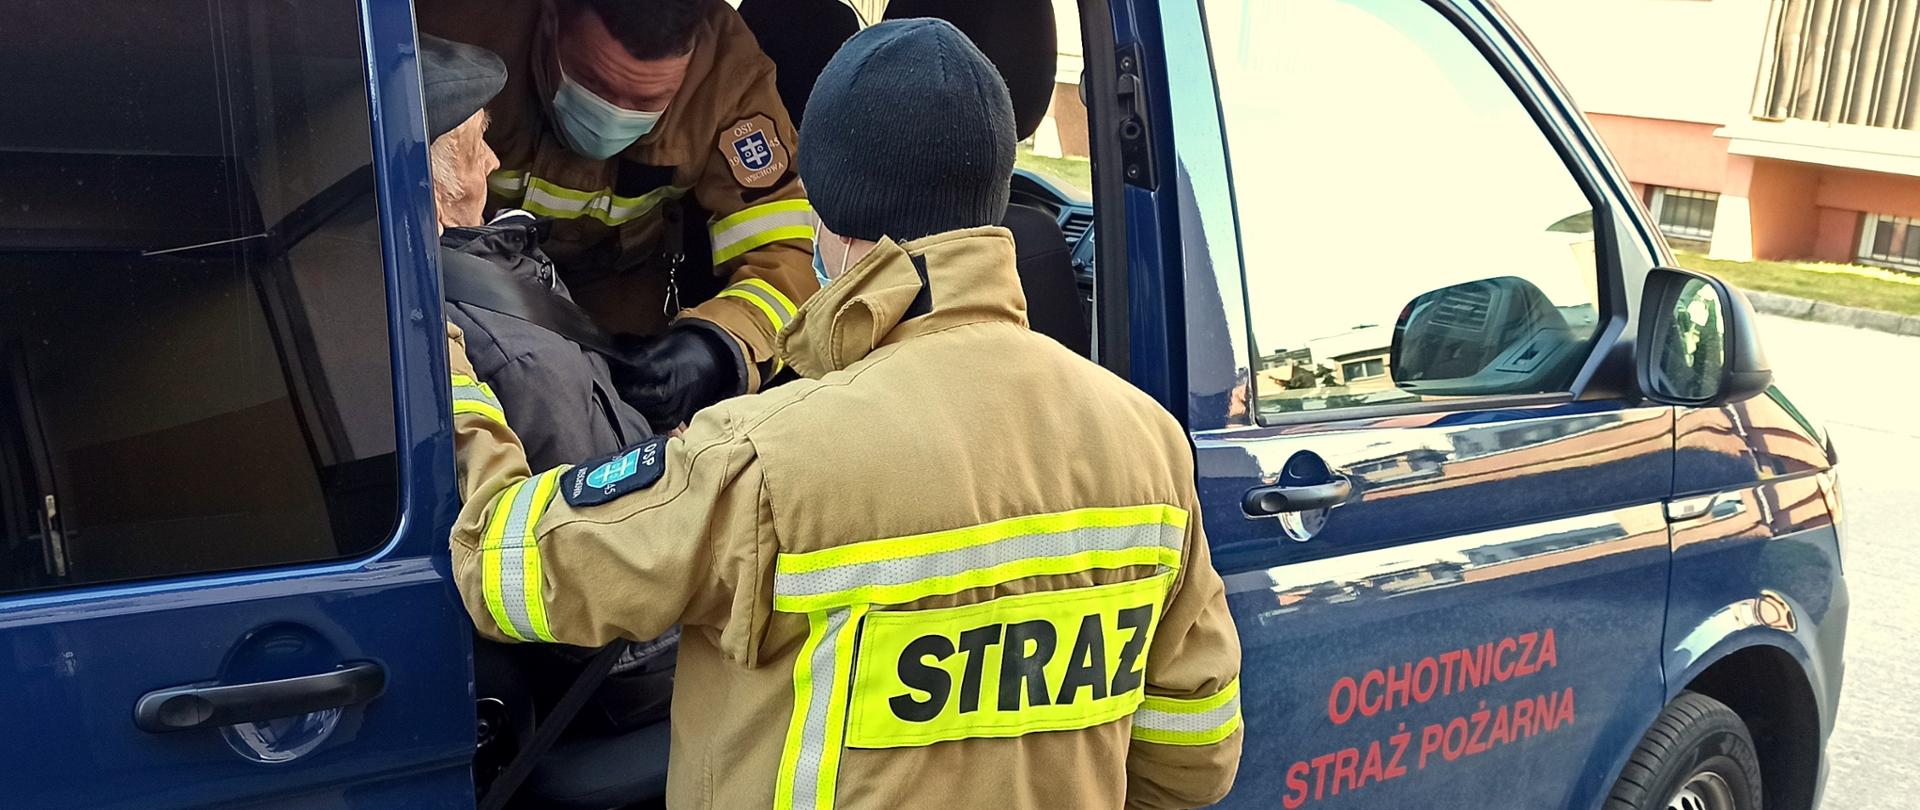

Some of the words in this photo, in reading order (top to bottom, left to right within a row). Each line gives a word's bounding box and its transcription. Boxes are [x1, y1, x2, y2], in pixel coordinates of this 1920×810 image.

[734, 122, 753, 137] OSP
[768, 137, 780, 148] 45
[729, 156, 740, 167] 19
[745, 161, 784, 183] WSCHOWA
[642, 443, 657, 466] OSP
[1328, 627, 1557, 725] OCHOTNICZA
[1282, 722, 1411, 809] STRAŻ
[1418, 687, 1575, 770] POŻARNA
